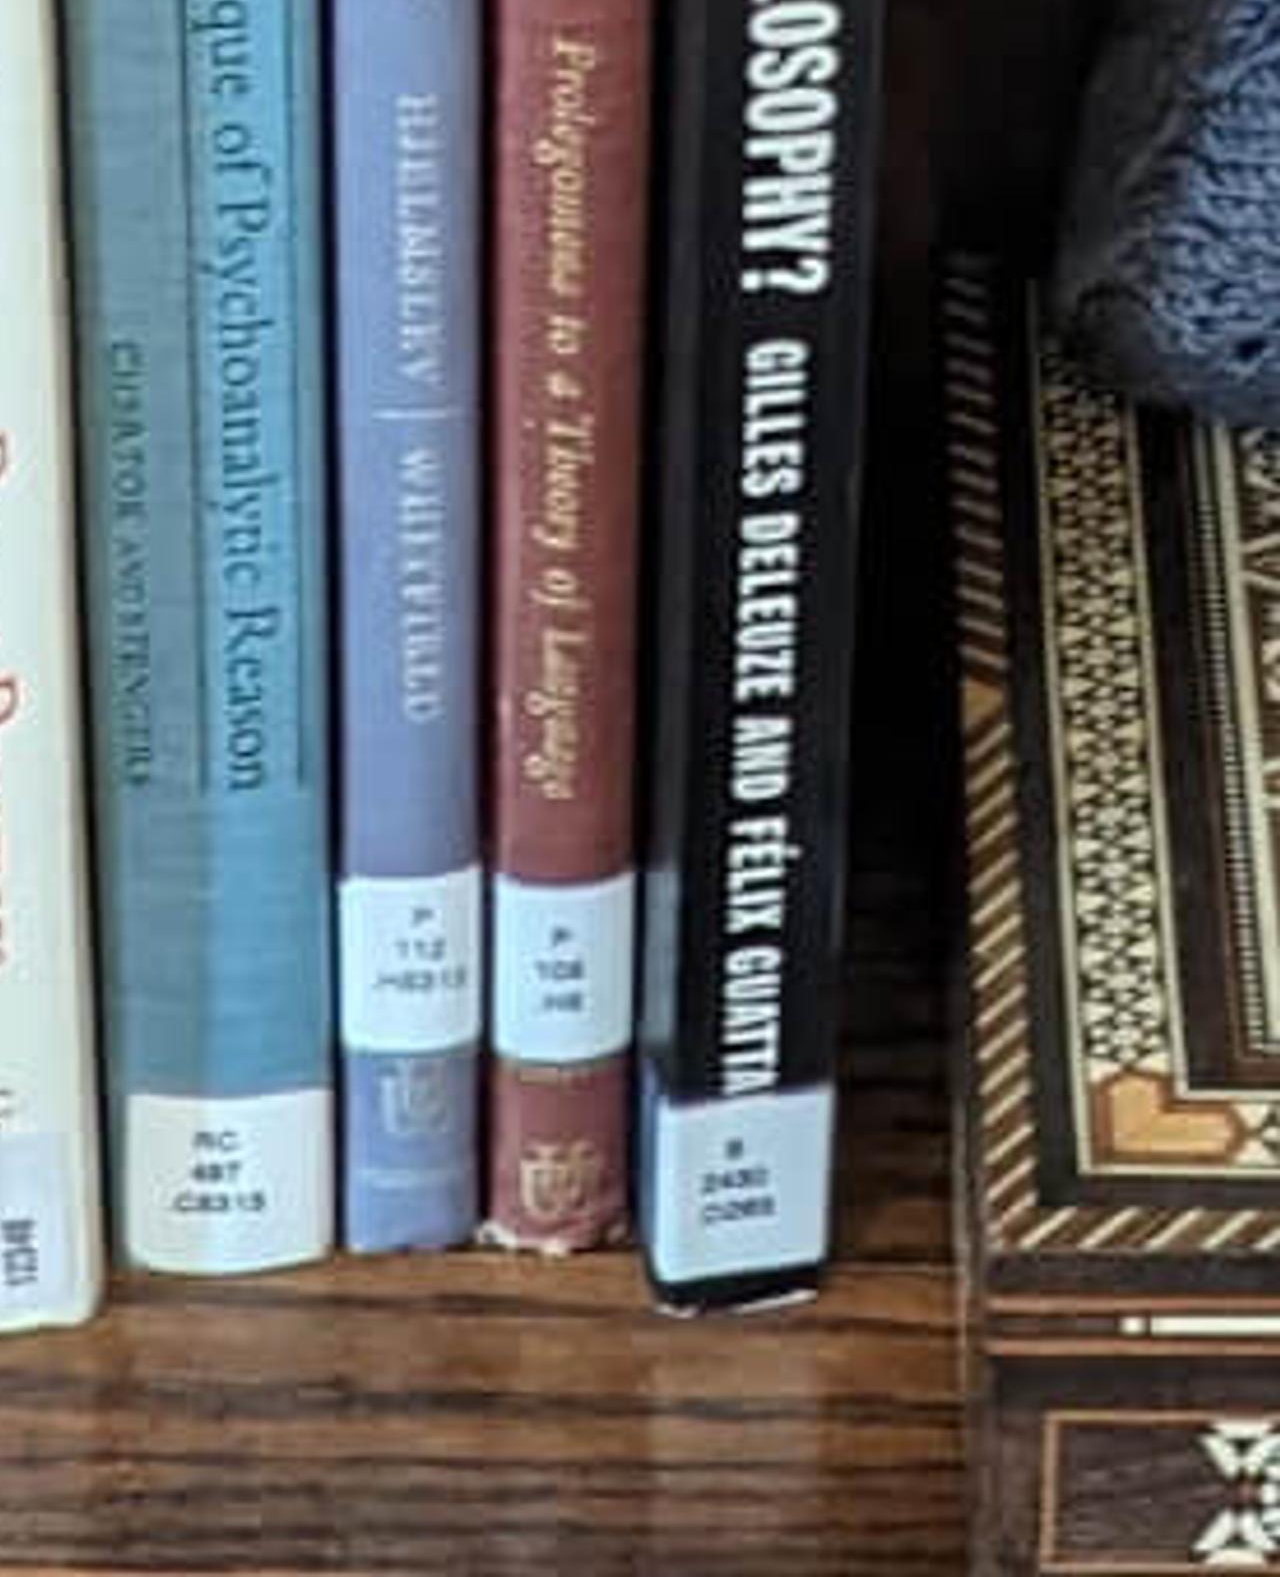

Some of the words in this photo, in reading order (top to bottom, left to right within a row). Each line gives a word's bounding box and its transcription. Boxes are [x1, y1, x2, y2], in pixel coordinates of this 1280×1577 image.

[211, 121, 276, 189] of
[535, 36, 604, 297] Prolegomena
[395, 92, 445, 384] HJELMSLEV
[204, 196, 278, 587] Psychoanalytic
[549, 371, 583, 401] a
[550, 311, 595, 360] to
[535, 414, 595, 552] Theory
[737, 338, 803, 498] GILLES
[396, 445, 448, 725] WHITFIELD
[539, 563, 595, 612] of
[732, 513, 799, 702] DELEUZE
[219, 605, 280, 794] Reason
[526, 626, 590, 805] Language
[727, 717, 793, 802] AND
[724, 815, 805, 934] FÉLIX
[192, 1130, 240, 1151] RC
